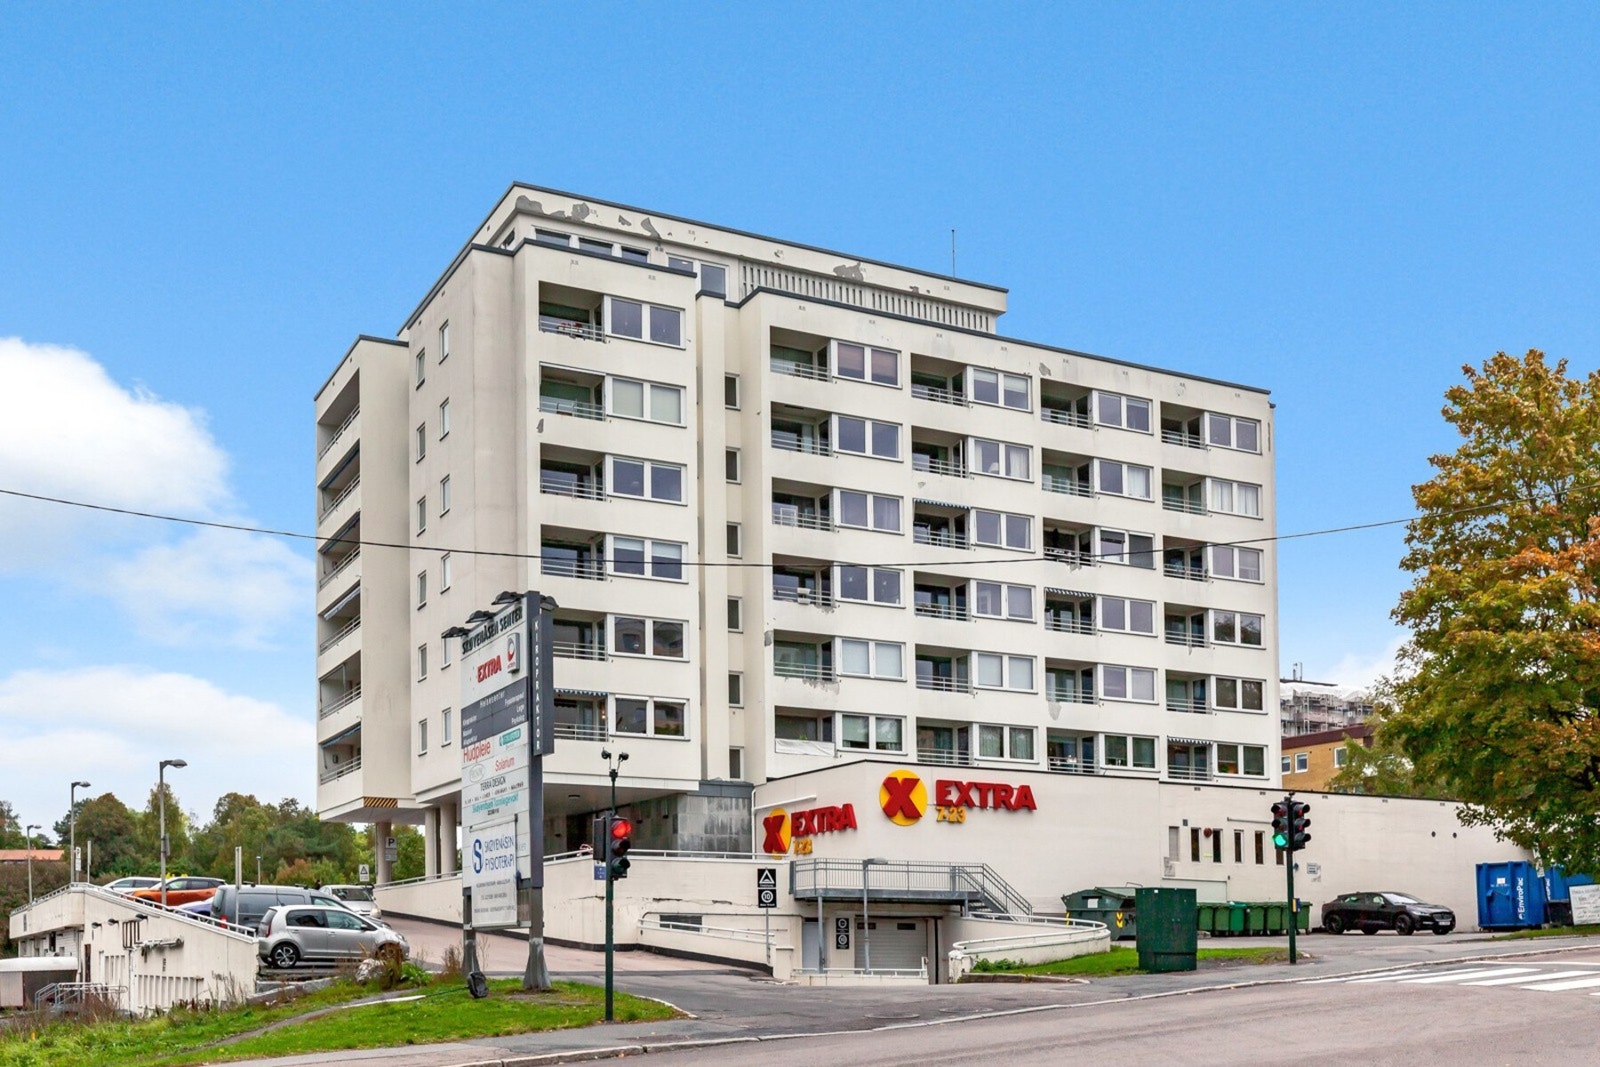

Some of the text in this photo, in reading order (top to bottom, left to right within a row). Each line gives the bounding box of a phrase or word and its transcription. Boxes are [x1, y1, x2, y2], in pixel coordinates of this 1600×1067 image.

[476, 655, 502, 683] EXTRA
[463, 741, 491, 763] Hudpleie
[495, 757, 515, 772] Solarium
[935, 779, 1038, 811] EXTRA
[790, 803, 857, 837] EXTRA
[936, 806, 967, 823] 7-23
[388, 837, 395, 847] P
[484, 854, 515, 873] FYSIOTERAPI
